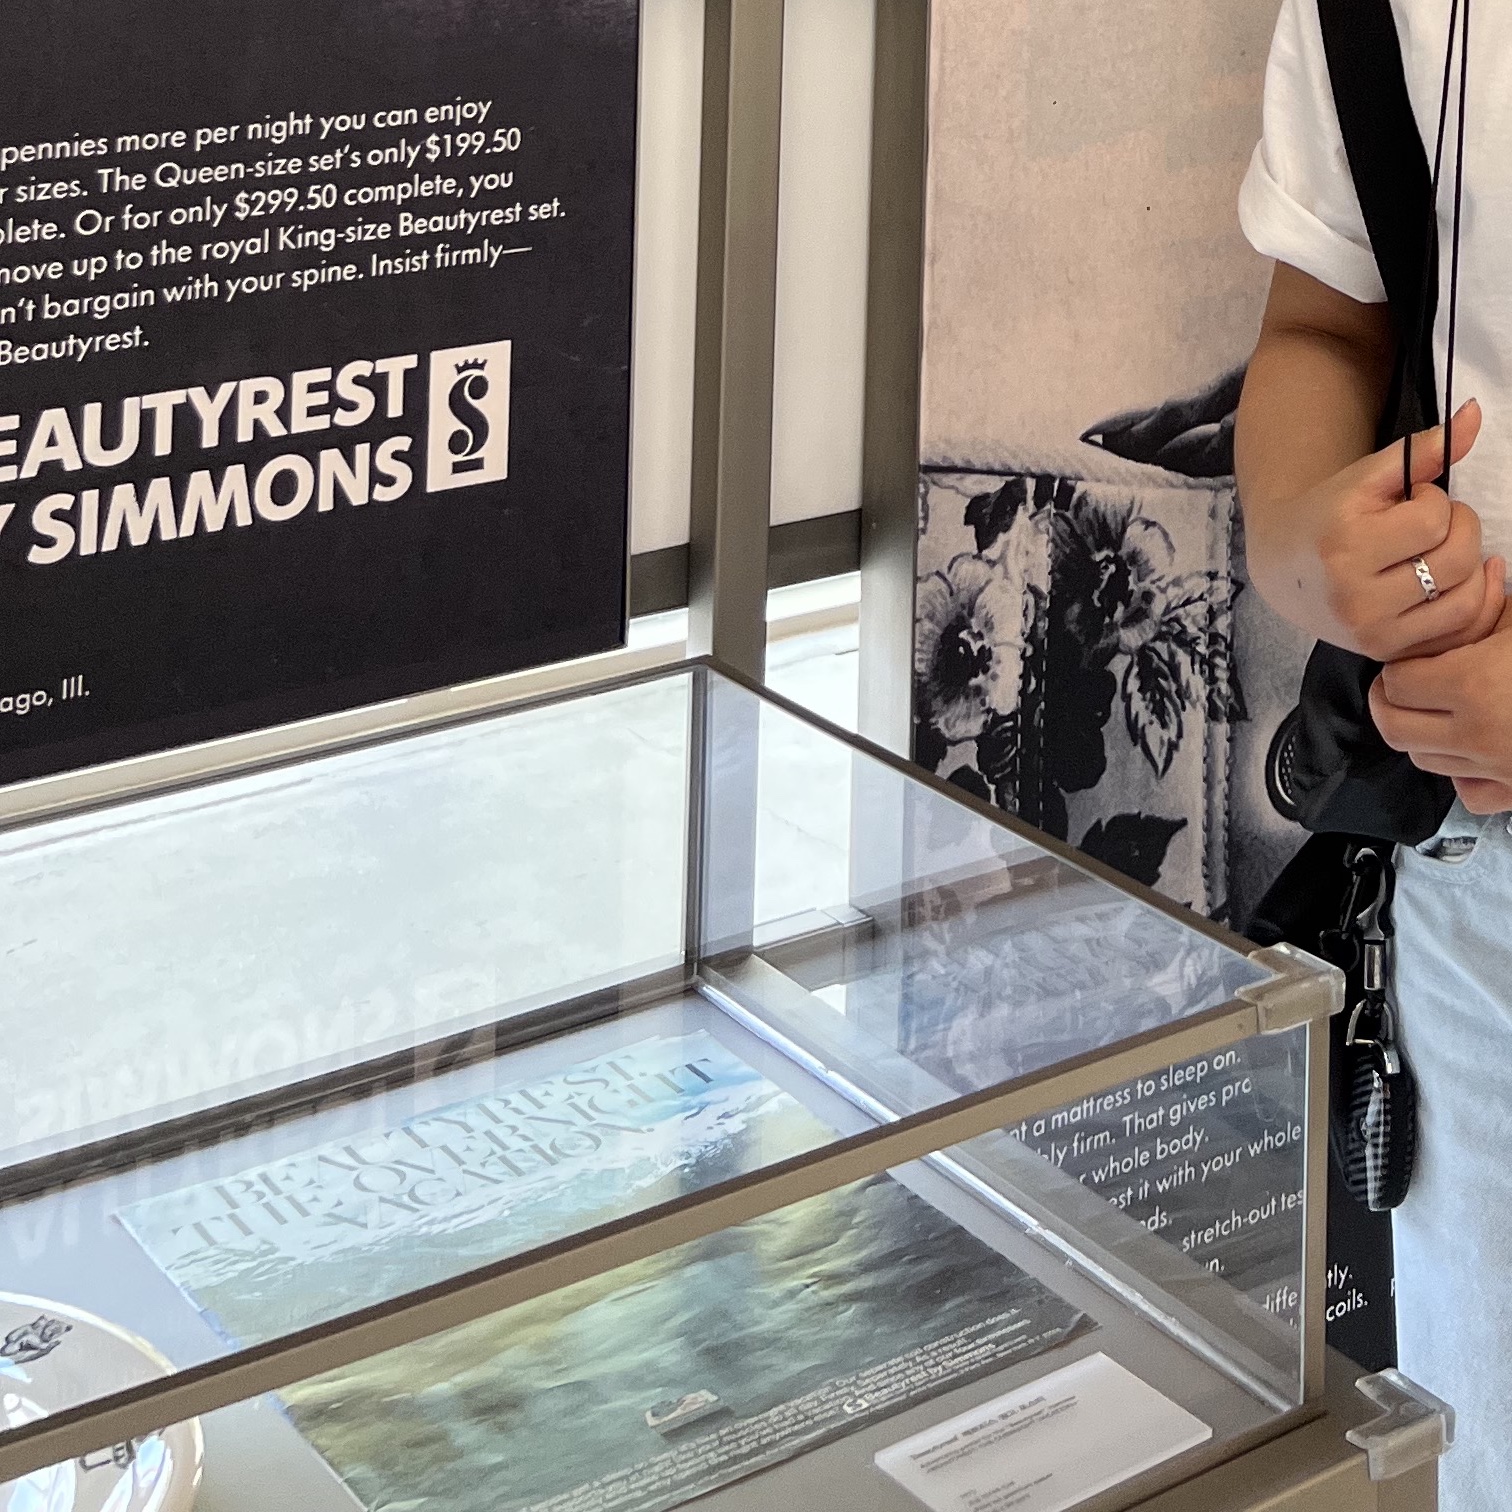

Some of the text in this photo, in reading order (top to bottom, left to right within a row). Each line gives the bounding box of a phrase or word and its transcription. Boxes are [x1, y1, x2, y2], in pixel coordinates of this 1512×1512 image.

[0, 96, 492, 171] pennies more per night you can enjoy
[14, 127, 522, 203] sizes. The Queen-size set's only $199.50
[0, 171, 513, 246] lete. Or for only $299.50 complete, you
[70, 256, 108, 282] up
[114, 249, 143, 272] to
[149, 239, 193, 267] the
[200, 228, 269, 264] royal
[278, 217, 392, 252] King-size
[398, 202, 523, 237] Beautyrest
[528, 197, 566, 221] set.
[41, 283, 155, 320] bargain
[162, 273, 219, 303] with
[225, 272, 286, 303] your
[289, 259, 364, 292] spine.
[371, 249, 431, 277] Insist
[0, 325, 150, 366] Beautyrest.
[27, 436, 413, 565] SIMMONS
[1033, 1051, 1241, 1137] a mattress to sleep on.
[1072, 1129, 1116, 1158] firm.
[1121, 1113, 1164, 1138] That
[1169, 1092, 1217, 1126] gives
[172, 1192, 344, 1248] THE
[353, 1057, 715, 1194] OVERNIGHT
[1092, 1148, 1150, 1185] whole
[1156, 1124, 1209, 1160] body.
[1138, 1121, 1301, 1201] it with your whole
[1182, 1195, 1277, 1252] stretch-out
[1325, 1287, 1369, 1322] coils.
